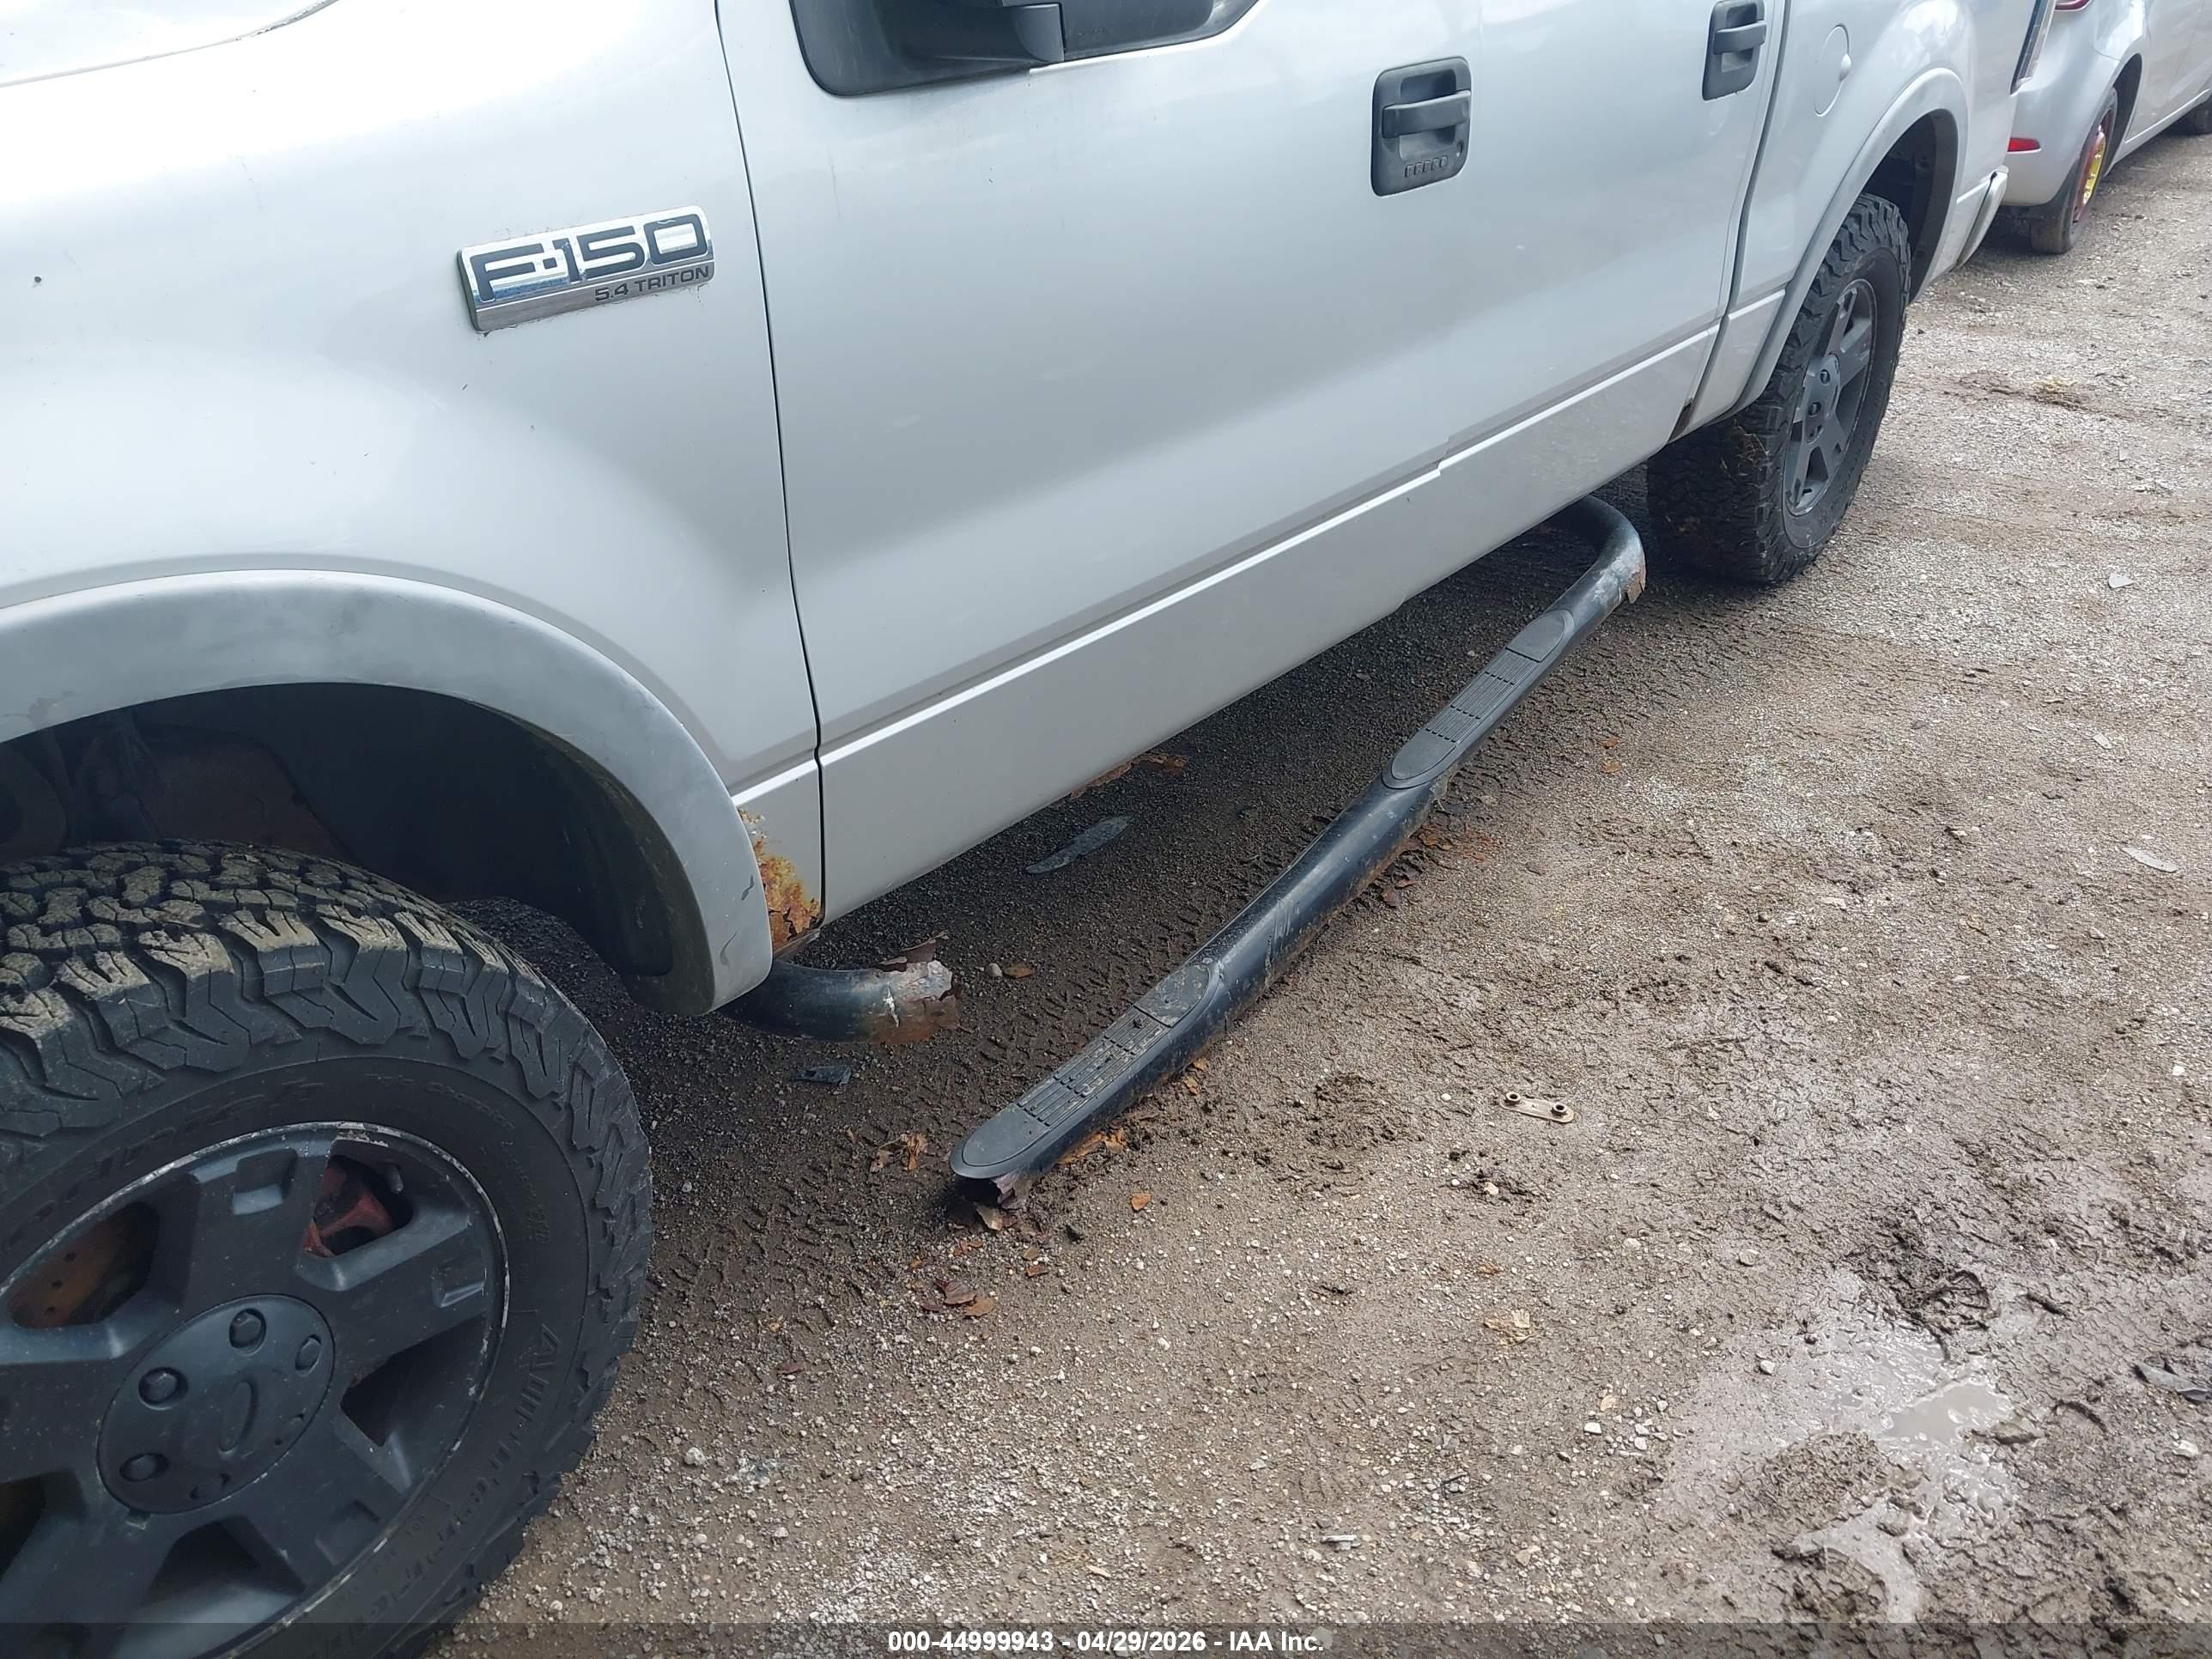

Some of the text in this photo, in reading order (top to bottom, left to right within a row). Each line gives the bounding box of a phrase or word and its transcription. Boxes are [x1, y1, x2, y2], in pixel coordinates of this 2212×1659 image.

[471, 214, 708, 301] F-150
[594, 265, 709, 301] 5.4 TRITON
